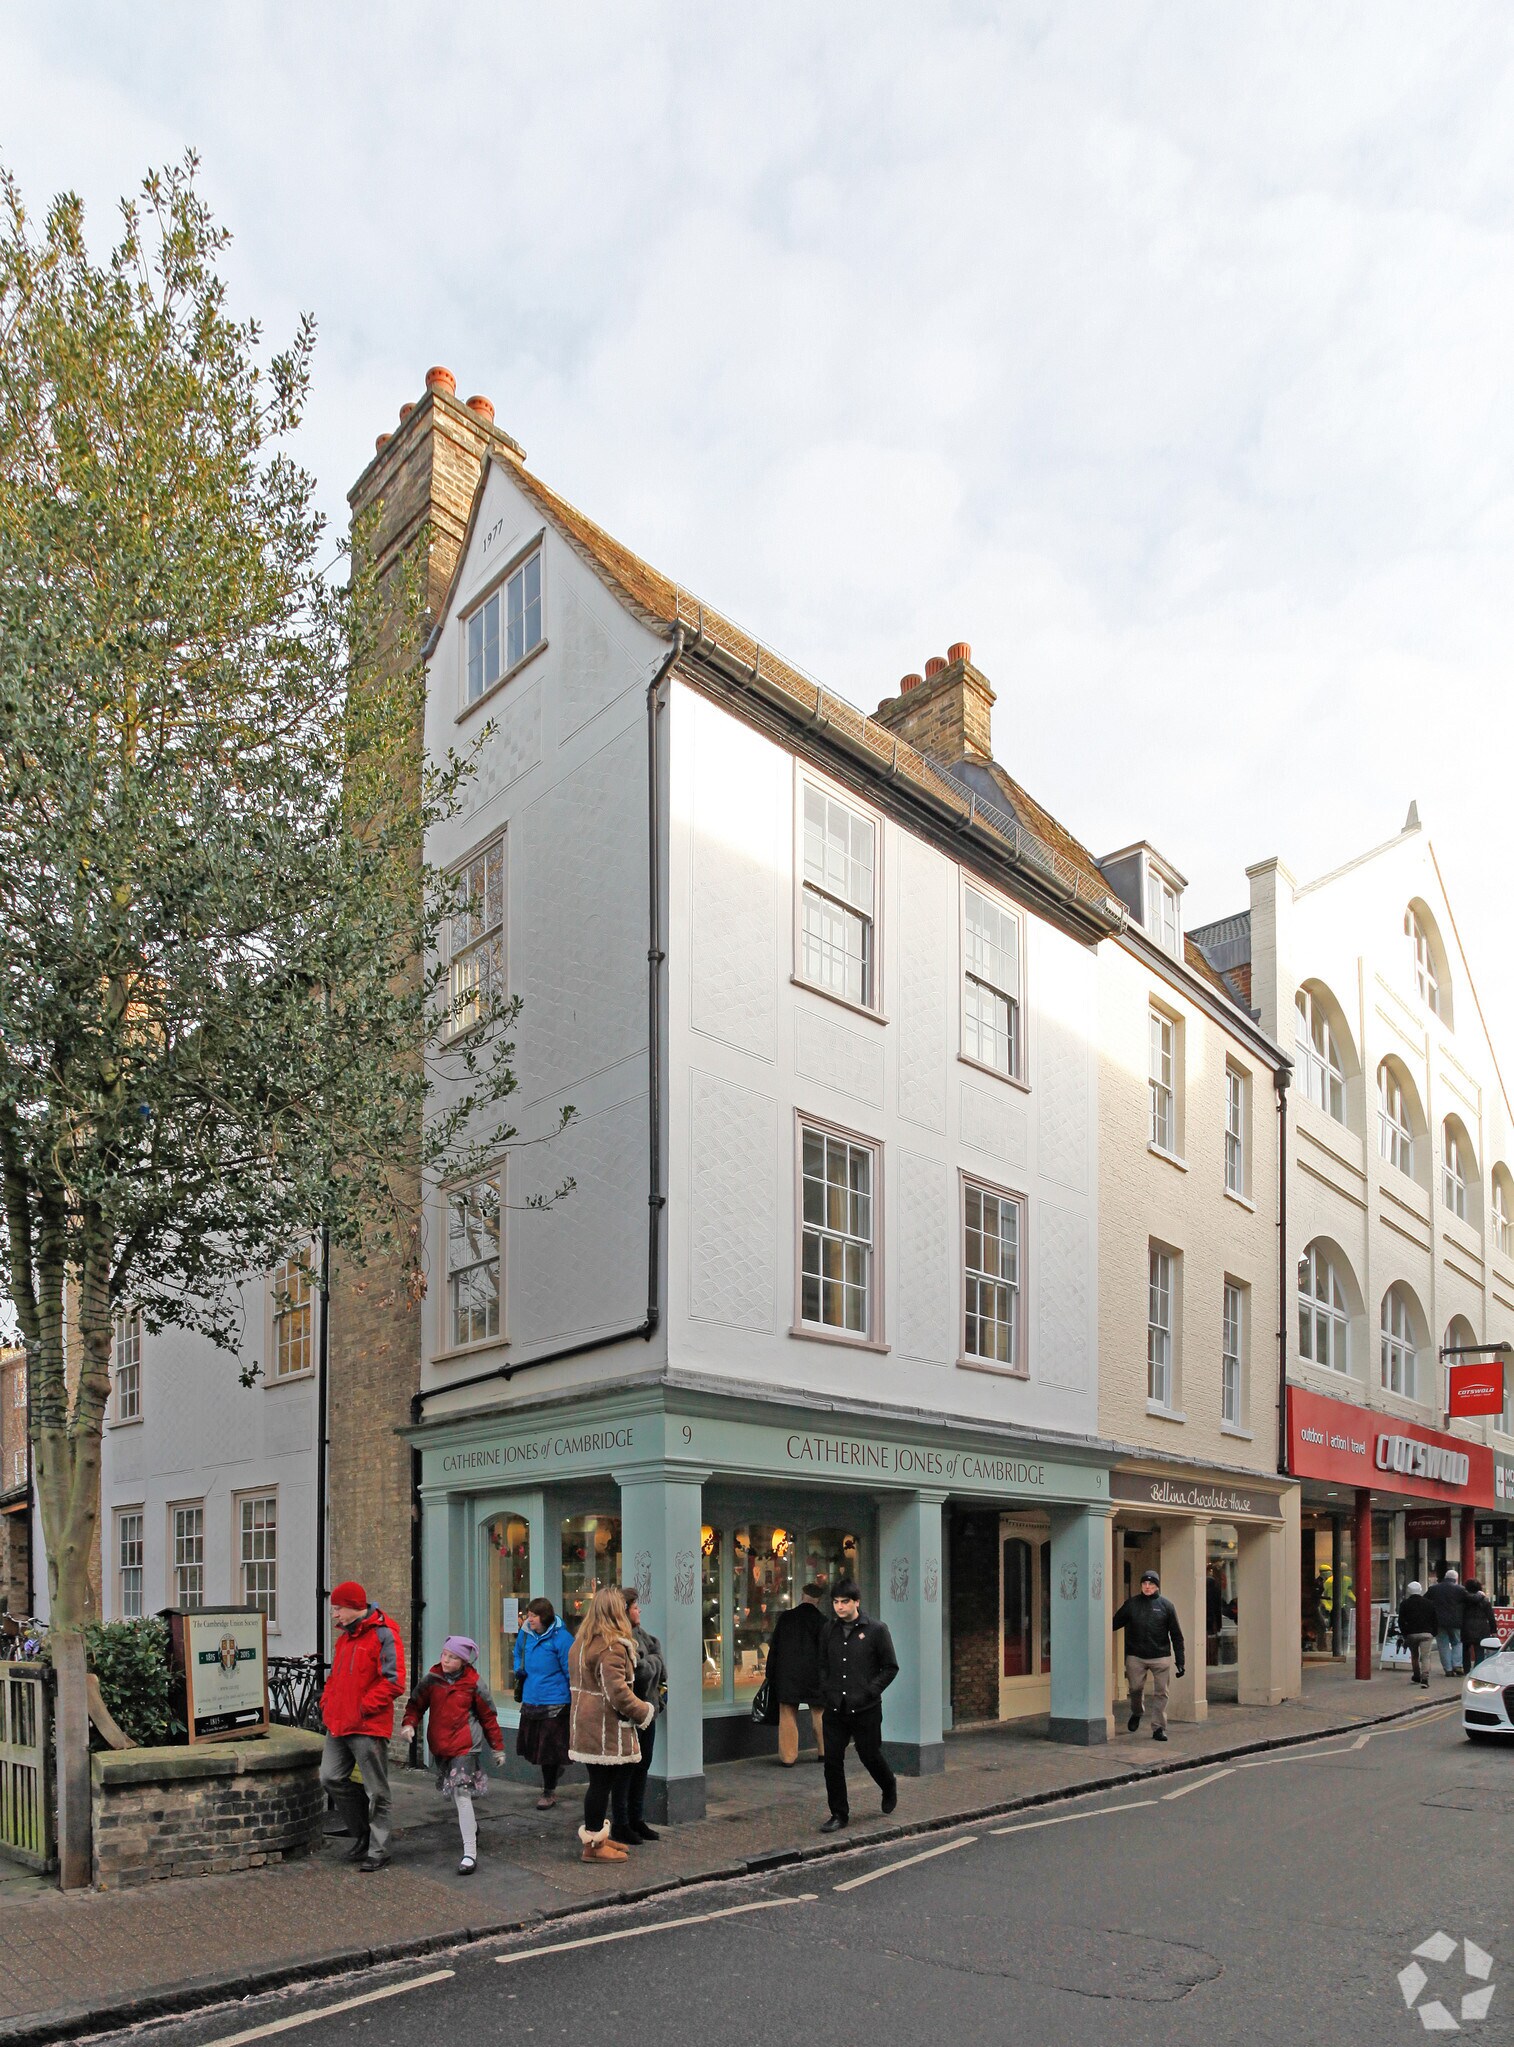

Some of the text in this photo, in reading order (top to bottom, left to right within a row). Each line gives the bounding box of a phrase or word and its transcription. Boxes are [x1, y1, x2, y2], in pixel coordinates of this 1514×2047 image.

[483, 518, 503, 553] 1977
[1457, 1387, 1495, 1396] COTSWOLD
[682, 1425, 692, 1445] 9
[1300, 1427, 1366, 1455] outdoor action travel
[443, 1428, 634, 1472] CATHERINE JONES of CAMBRIDGE
[786, 1435, 1045, 1485] CATHERINE JONES of CAMBRIDGE
[1376, 1433, 1470, 1486] COTSWOLD
[1096, 1475, 1102, 1489] 9
[1150, 1481, 1251, 1511] Bellina Chocolate House
[203, 1619, 229, 1629] Cambridge
[230, 1619, 244, 1627] Union
[205, 1653, 216, 1662] 1815
[240, 1650, 250, 1659] 2015
